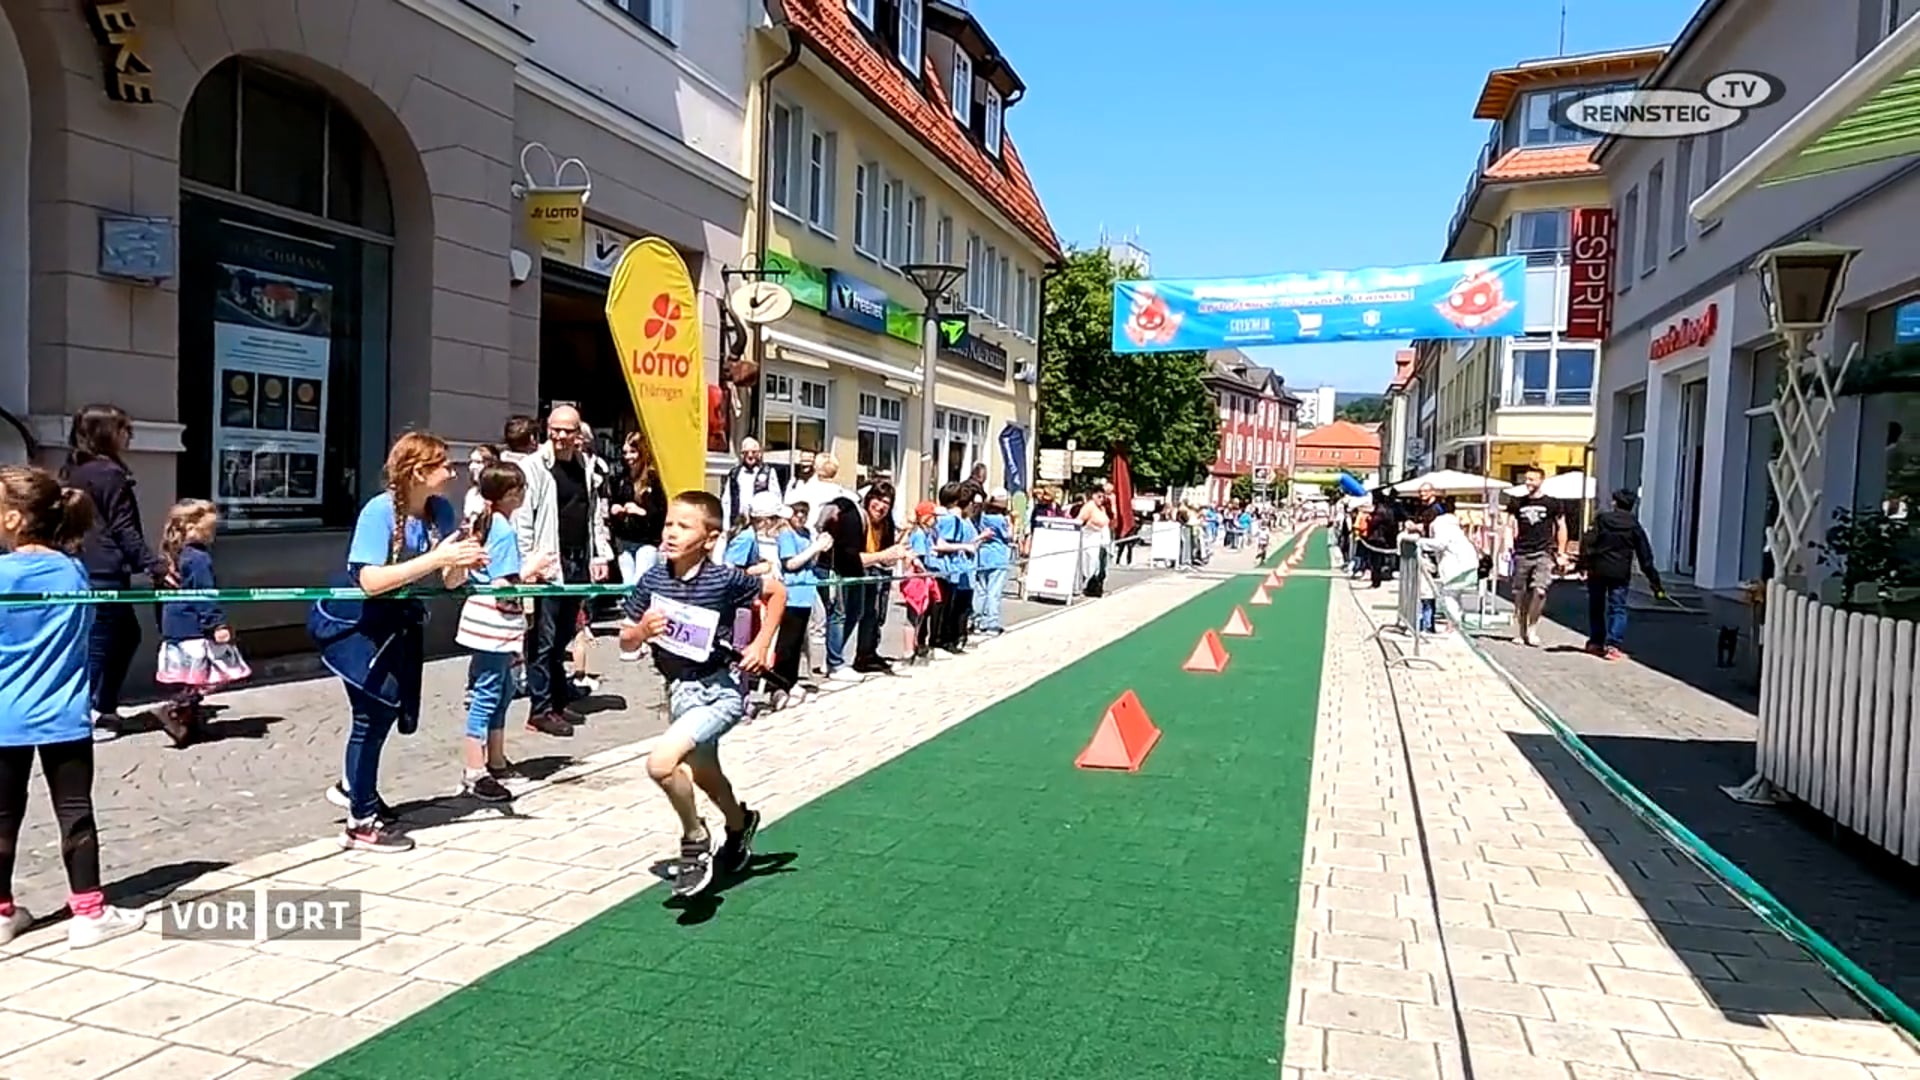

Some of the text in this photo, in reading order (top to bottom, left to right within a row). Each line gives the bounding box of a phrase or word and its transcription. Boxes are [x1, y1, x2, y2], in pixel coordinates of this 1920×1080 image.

[545, 207, 580, 219] LOTTO
[1571, 213, 1609, 333] ESPRIT
[633, 349, 690, 378] LOTTO
